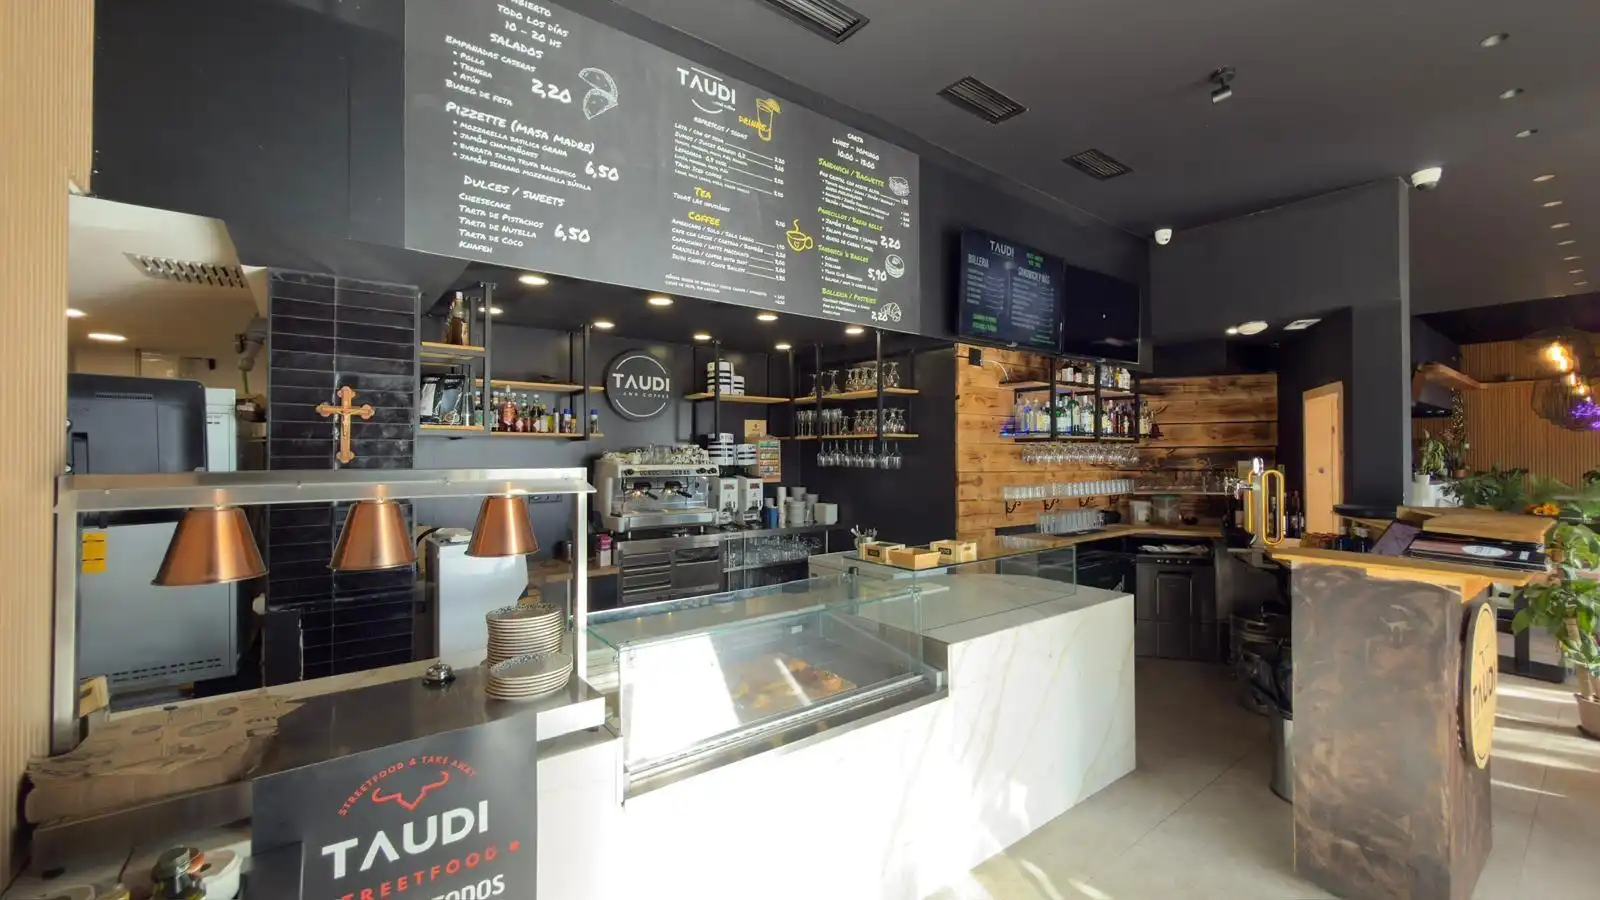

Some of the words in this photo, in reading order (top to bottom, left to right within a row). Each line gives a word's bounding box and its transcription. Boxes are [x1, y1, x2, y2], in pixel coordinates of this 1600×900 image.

[497, 4, 523, 20] TODO
[526, 16, 546, 28] LOS
[505, 20, 517, 32] 10
[532, 30, 546, 44] 20
[445, 35, 500, 60] EMPANADAS
[501, 57, 536, 72] CASERAS
[490, 33, 544, 59] SALADOS
[460, 52, 485, 66] POLLO
[460, 62, 493, 79] TERNERA
[531, 78, 571, 103] 2,20
[676, 67, 736, 105] TAUDI
[479, 90, 490, 99] DE
[493, 95, 513, 107] FETA
[446, 101, 508, 128] PIZZETTE
[511, 119, 549, 141] (MASA
[553, 136, 595, 155] MADRE)
[460, 122, 508, 140] MOZZARELLA
[585, 161, 619, 181] 6,50
[459, 192, 512, 210] CHEESECAKE
[464, 173, 510, 194] DULCES
[522, 190, 566, 207] SWEETS
[694, 186, 712, 199] TEA
[459, 204, 487, 217] TARTA
[488, 211, 499, 220] DE
[501, 213, 544, 231] PISTACHOS
[459, 216, 487, 229] TARTA
[488, 222, 499, 232] DE
[501, 225, 537, 240] NUTELLA
[688, 211, 720, 227] COFFEE
[459, 228, 487, 241] TARTA
[488, 234, 499, 244] DE
[501, 236, 524, 248] COCO
[554, 223, 591, 243] 6,50
[880, 235, 901, 250] 2,20
[990, 240, 1014, 258] TAUDI
[868, 267, 887, 282] 5,90
[612, 373, 670, 392] TAUDI
[336, 762, 404, 817] STREETFOOD
[422, 755, 449, 765] TAKE
[321, 799, 489, 880] TAUDI
[341, 845, 498, 900] REETFOOD
[428, 873, 506, 900] ODOS
